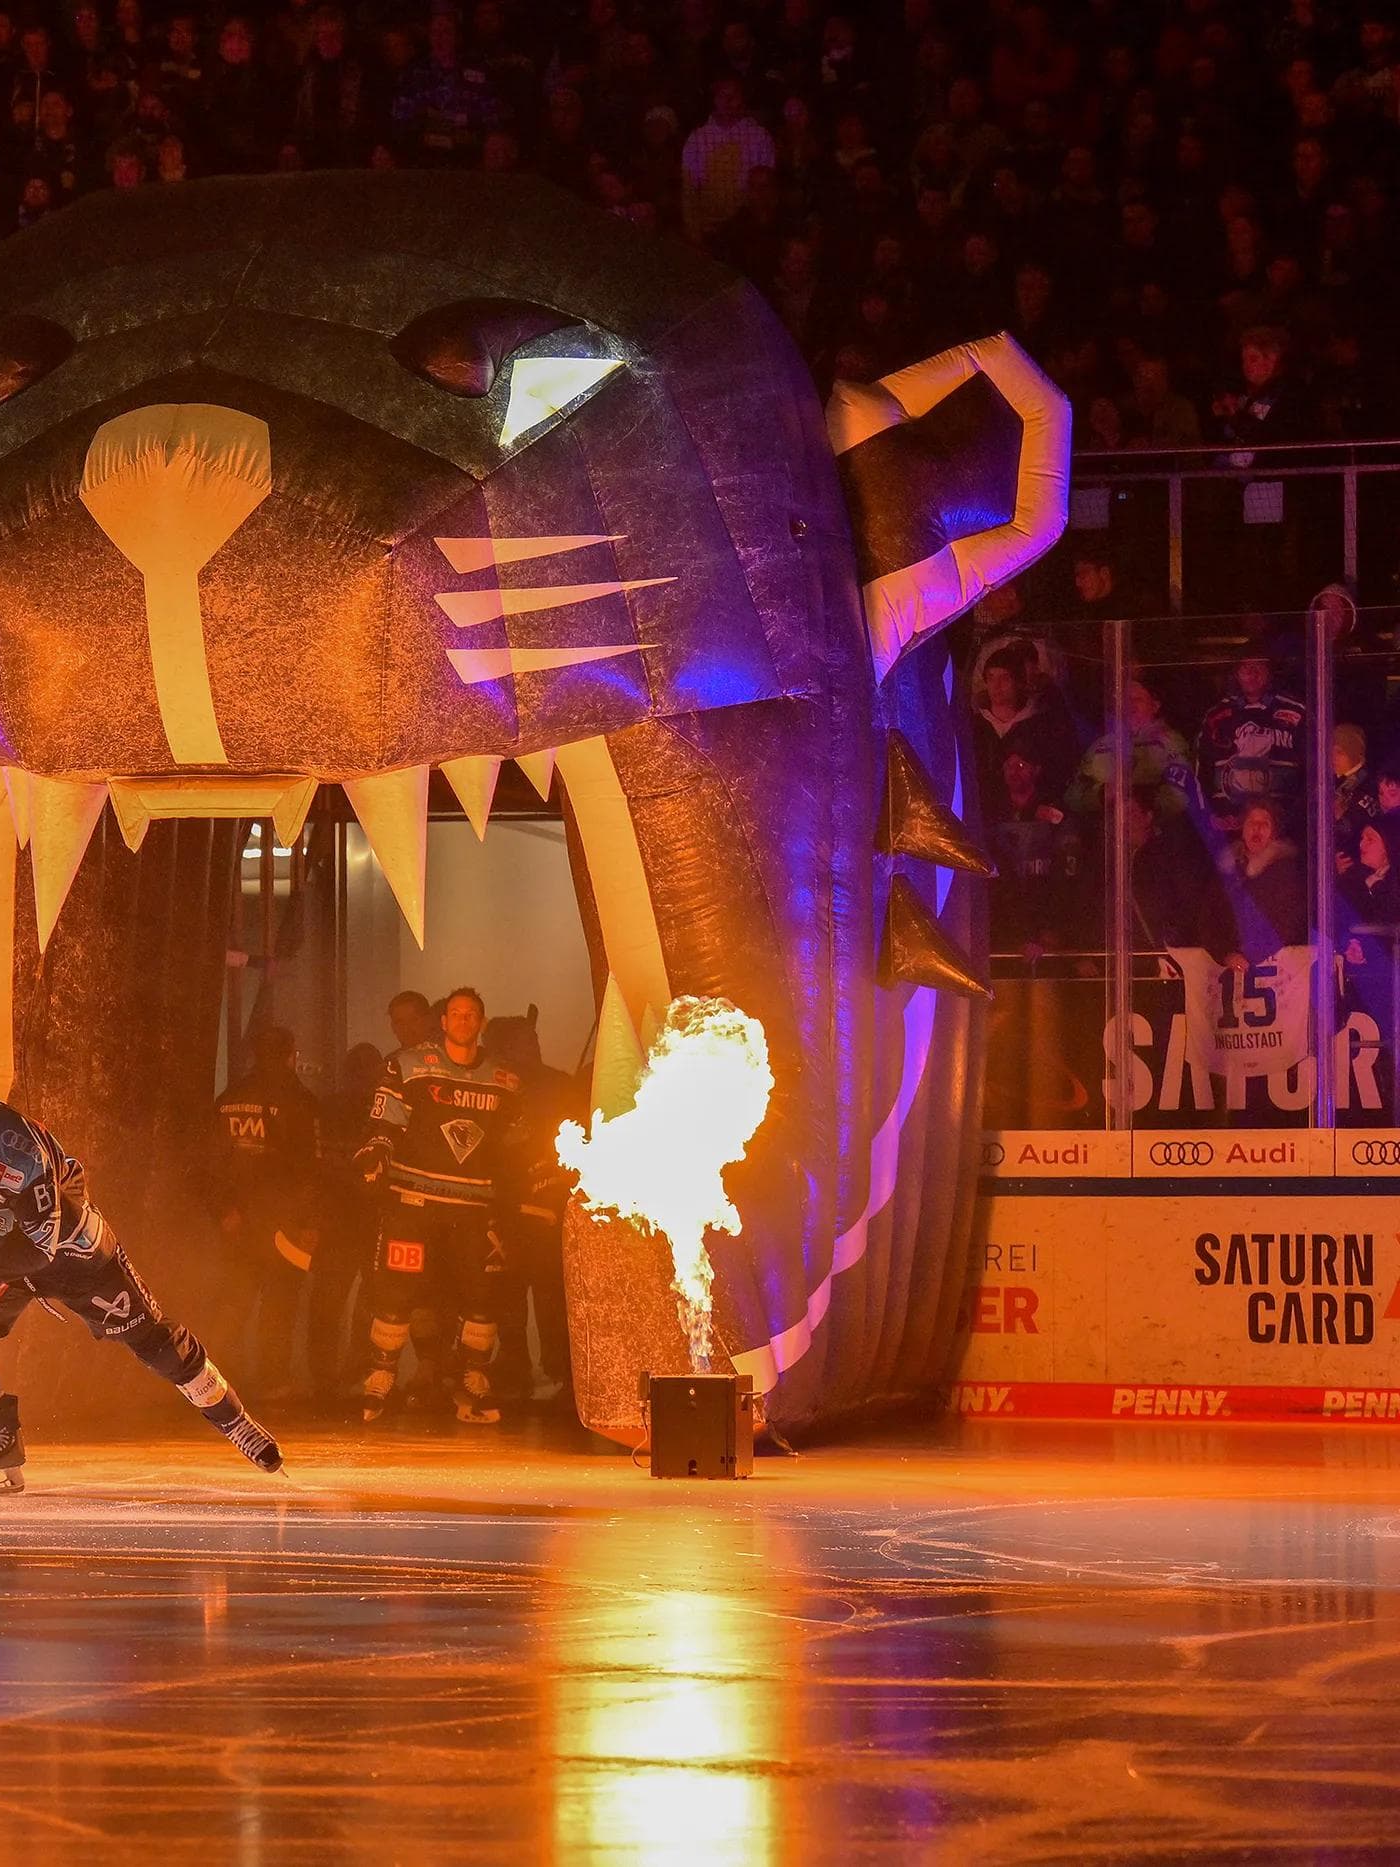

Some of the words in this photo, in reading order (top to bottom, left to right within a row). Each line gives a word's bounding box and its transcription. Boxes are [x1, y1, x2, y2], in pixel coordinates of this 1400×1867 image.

[1217, 963, 1278, 1028] 15
[1214, 1031, 1283, 1049] INGOLSTADT
[1017, 1144, 1089, 1166] Audi
[1225, 1143, 1297, 1164] Audi
[390, 1246, 420, 1266] DB
[1194, 1233, 1374, 1286] SATURN
[105, 1313, 146, 1335] BAUER
[1247, 1292, 1375, 1344] CARD
